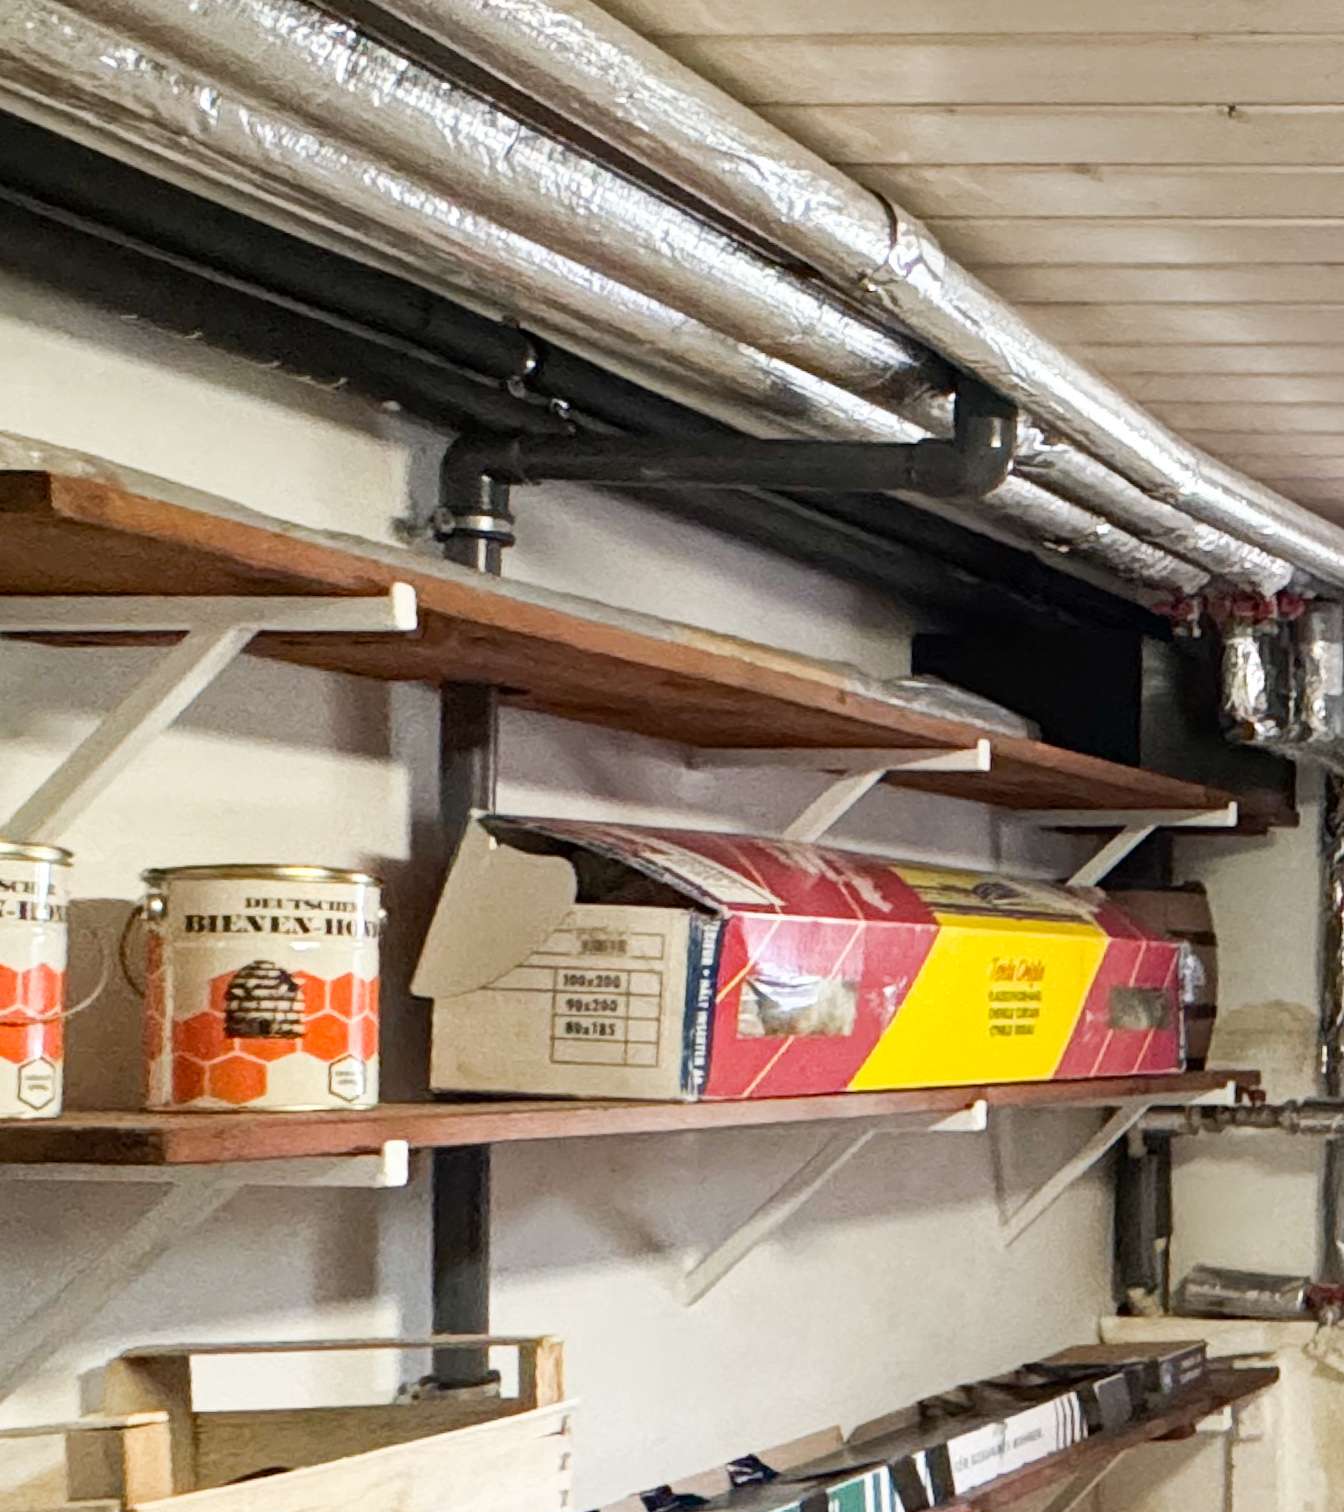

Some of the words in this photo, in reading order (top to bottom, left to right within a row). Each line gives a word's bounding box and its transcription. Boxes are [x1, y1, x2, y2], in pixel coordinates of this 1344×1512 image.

[563, 974, 622, 989] 100x200
[565, 999, 618, 1013] 90x200
[564, 1021, 617, 1036] 80x185
